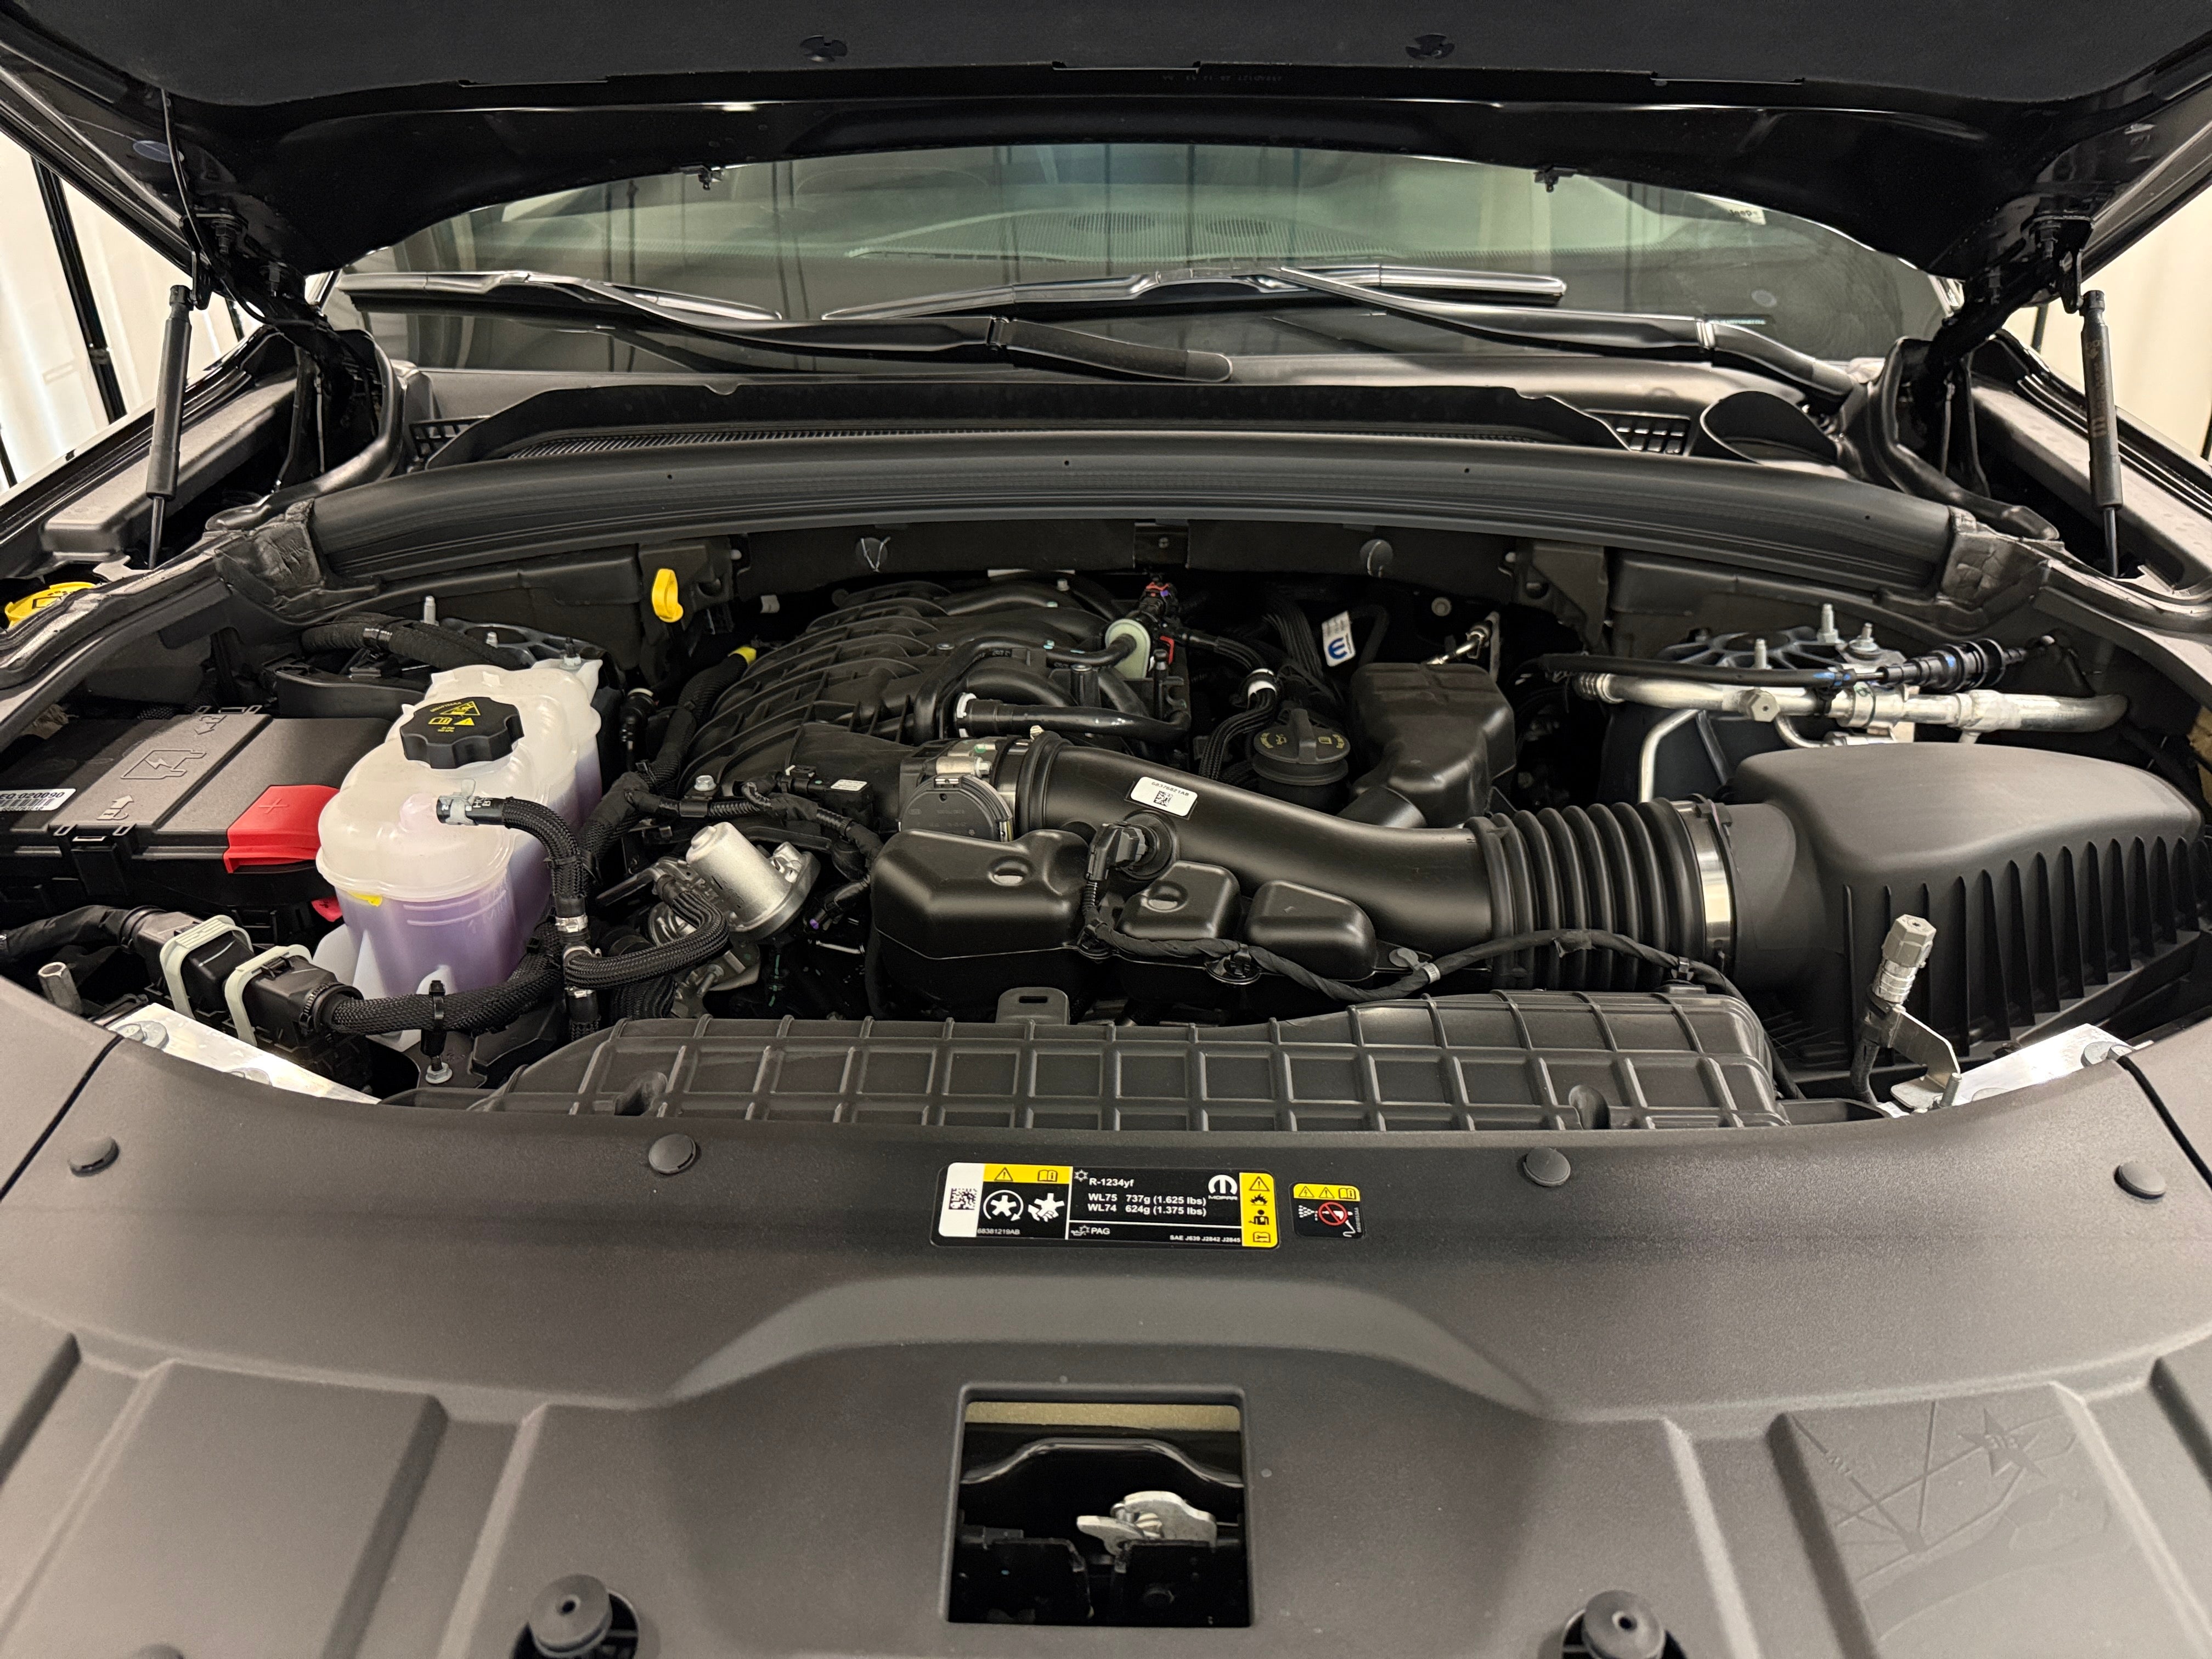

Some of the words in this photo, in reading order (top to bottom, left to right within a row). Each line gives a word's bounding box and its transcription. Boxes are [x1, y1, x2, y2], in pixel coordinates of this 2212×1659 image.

[1089, 1178, 1134, 1188] R-1234yf
[1088, 1193, 1118, 1202] WL75
[1126, 1194, 1150, 1204] 737g
[1153, 1195, 1184, 1205] (1.625
[1187, 1196, 1206, 1206] lbs)
[1087, 1203, 1117, 1212] WL74
[1125, 1205, 1150, 1215] 624g
[1153, 1206, 1184, 1215] (1.375
[1187, 1207, 1207, 1217] lbs)
[1091, 1227, 1110, 1235] PAG
